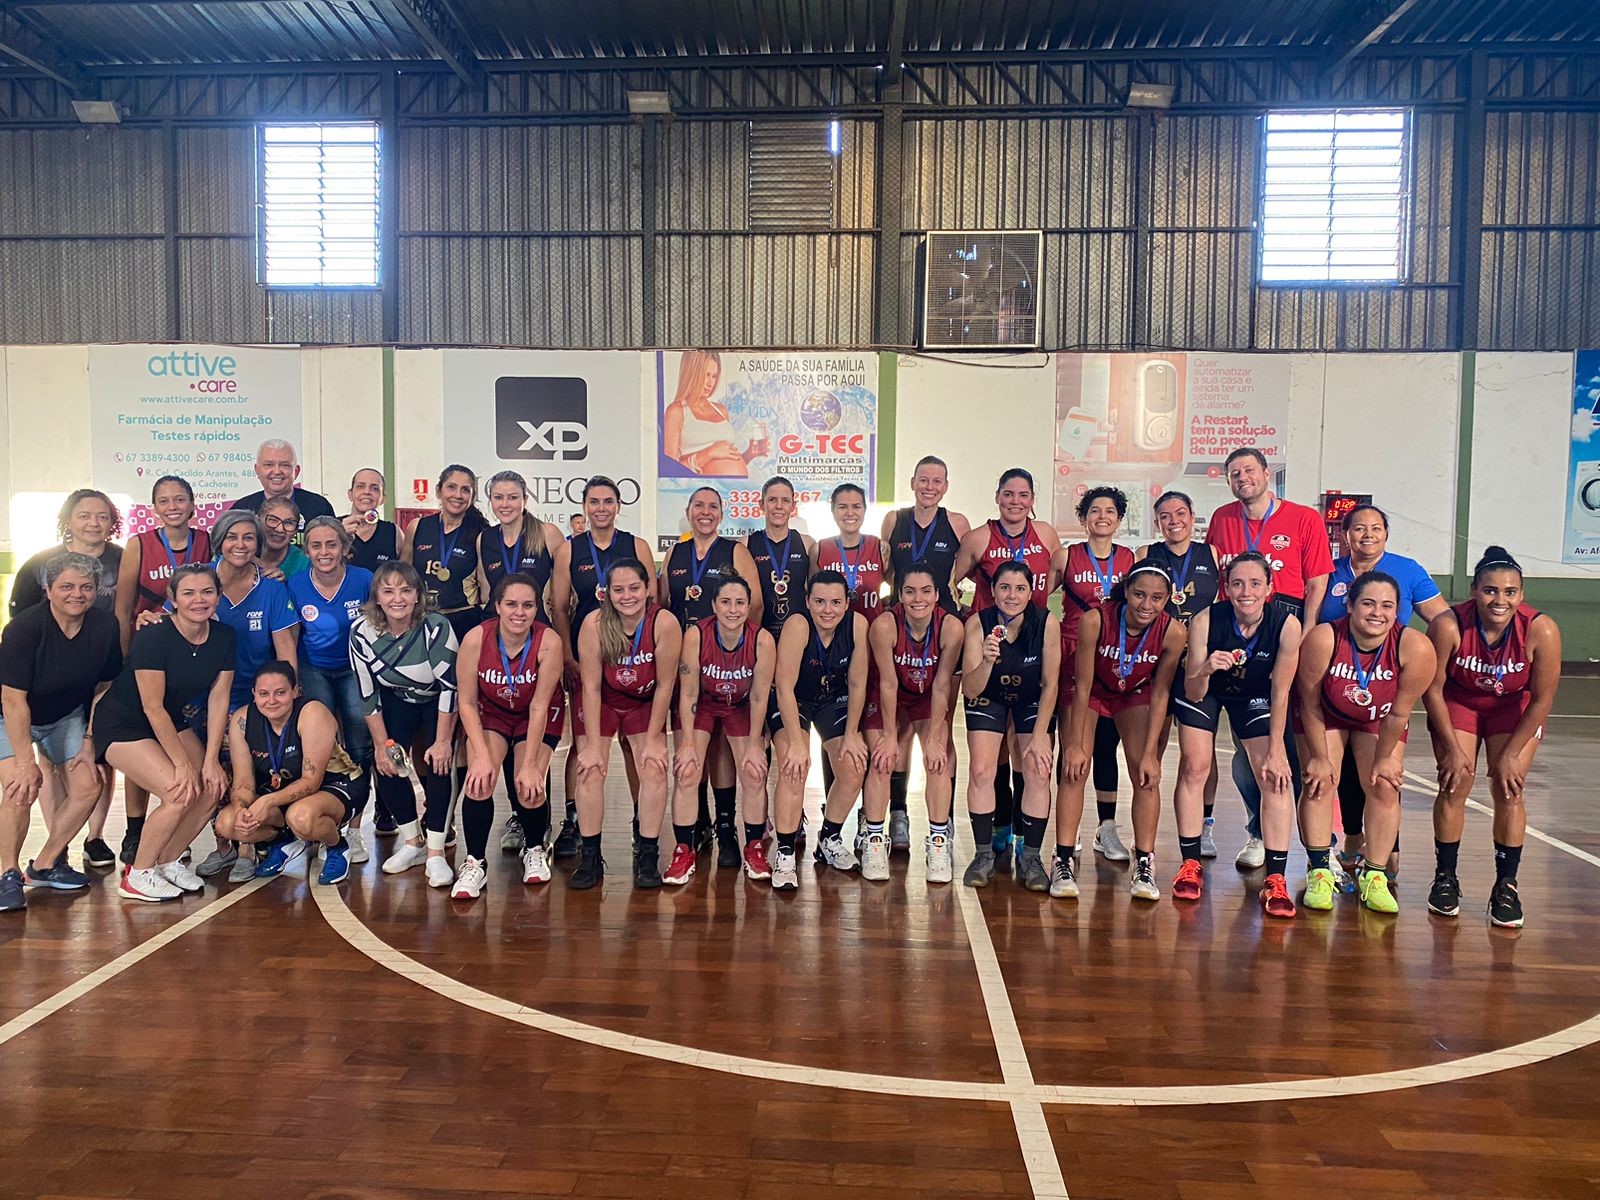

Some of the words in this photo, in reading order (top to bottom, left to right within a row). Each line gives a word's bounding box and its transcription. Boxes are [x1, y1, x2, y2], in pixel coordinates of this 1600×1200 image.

[148, 351, 236, 377] attive
[739, 360, 746, 372] A
[748, 357, 782, 372] SAÚDE
[786, 360, 800, 372] DA
[802, 360, 823, 372] SUA
[825, 357, 865, 372] FAMÍLIA
[1193, 359, 1218, 368] Quer
[1193, 368, 1252, 376] automatizar
[781, 374, 815, 386] PASSA
[817, 374, 838, 386] POR
[840, 374, 865, 387] AQUI
[1193, 384, 1219, 392] ainda
[140, 395, 248, 404] www.attivecare.com.br
[1192, 401, 1205, 409] de
[1207, 400, 1246, 409] alarme?
[118, 413, 173, 425] Farmácia
[176, 414, 192, 425] de
[194, 414, 273, 429] Manipulação
[1191, 415, 1201, 425] A
[1204, 415, 1249, 425] Restart
[1191, 426, 1215, 435] tem
[1228, 425, 1276, 437] solução
[151, 430, 191, 441] Testes
[194, 430, 240, 444] rápidos
[516, 421, 588, 460] XP
[1190, 436, 1218, 447] pelo
[1220, 437, 1256, 447] preço
[778, 434, 864, 455] G-TEC
[1190, 446, 1206, 455] de
[126, 454, 137, 462] 67
[140, 454, 190, 462] 3389-4300
[208, 453, 220, 462] 67
[223, 453, 256, 462] 98405-
[779, 456, 863, 464] Multimarcas
[726, 528, 734, 536] 13
[736, 528, 747, 536] de
[1032, 573, 1047, 591] 15
[863, 591, 878, 609] 10
[551, 706, 560, 723] 7
[1368, 702, 1393, 721] 13
